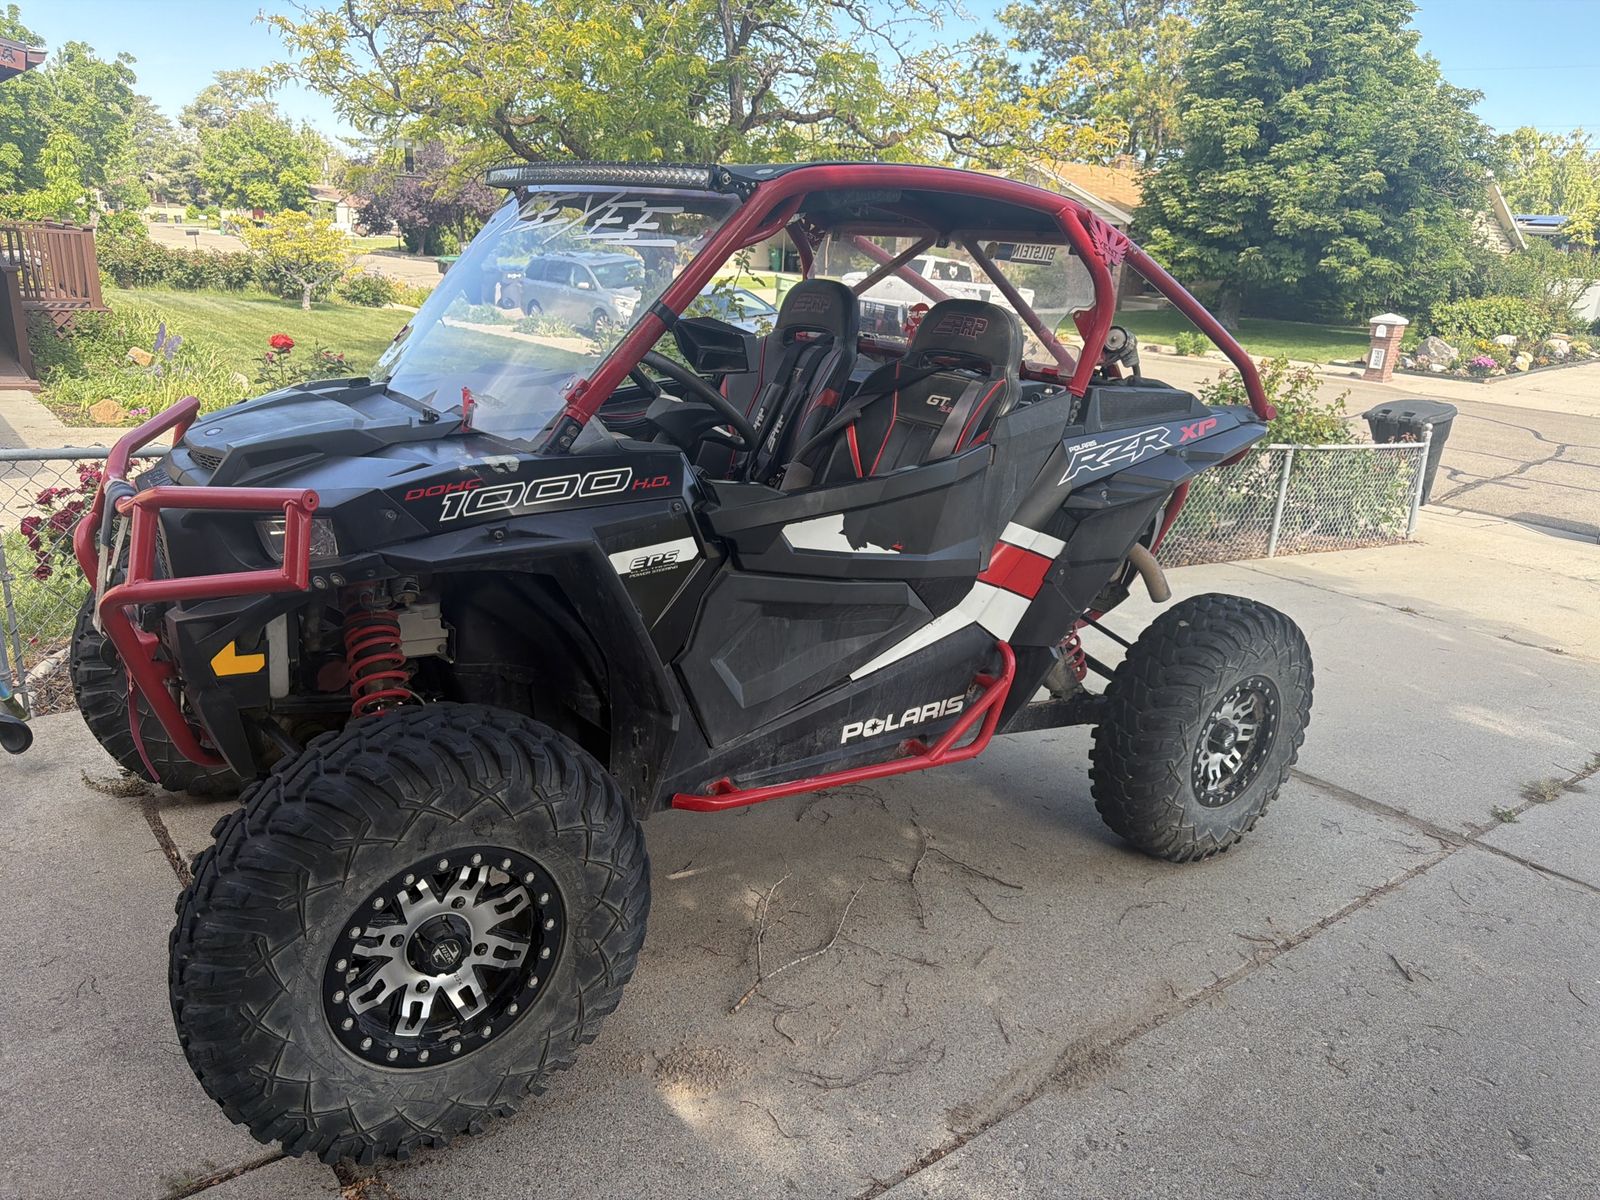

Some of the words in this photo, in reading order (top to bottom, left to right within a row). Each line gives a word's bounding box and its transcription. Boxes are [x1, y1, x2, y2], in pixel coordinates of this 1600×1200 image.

[932, 312, 989, 339] PRP
[926, 394, 952, 407] GT
[1057, 426, 1173, 486] RZR
[1178, 417, 1217, 443] XP
[1069, 440, 1097, 453] POLARIS
[404, 478, 484, 502] DOHC
[439, 467, 633, 522] 1000
[629, 549, 680, 570] EPS
[628, 569, 651, 579] POWER
[651, 565, 679, 575] STEERING
[840, 694, 966, 744] POLARIS
[439, 944, 454, 964] TUSK
